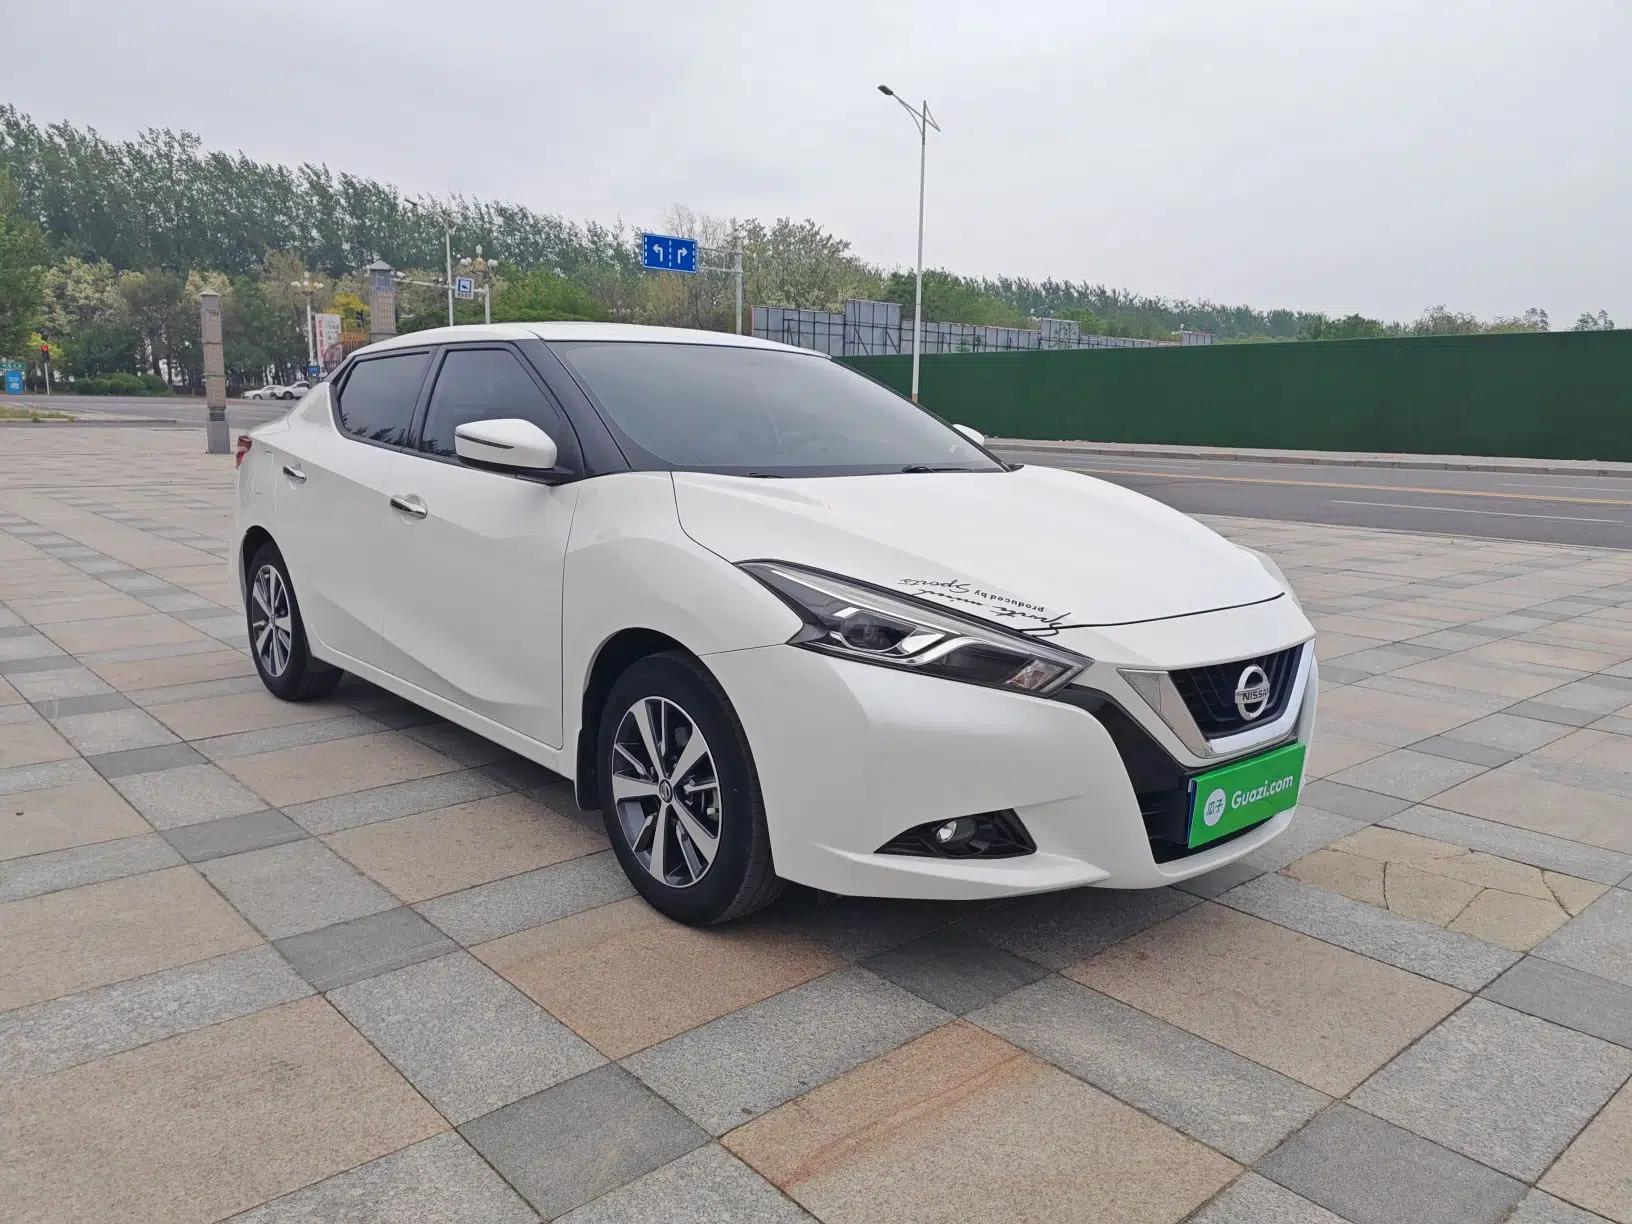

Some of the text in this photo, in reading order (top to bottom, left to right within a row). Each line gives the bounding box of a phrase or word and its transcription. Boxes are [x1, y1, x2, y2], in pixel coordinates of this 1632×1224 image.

[897, 578, 1045, 613] produced by Sports
[1206, 799, 1224, 816] 瓜子
[1231, 775, 1294, 809] Guazi.com
